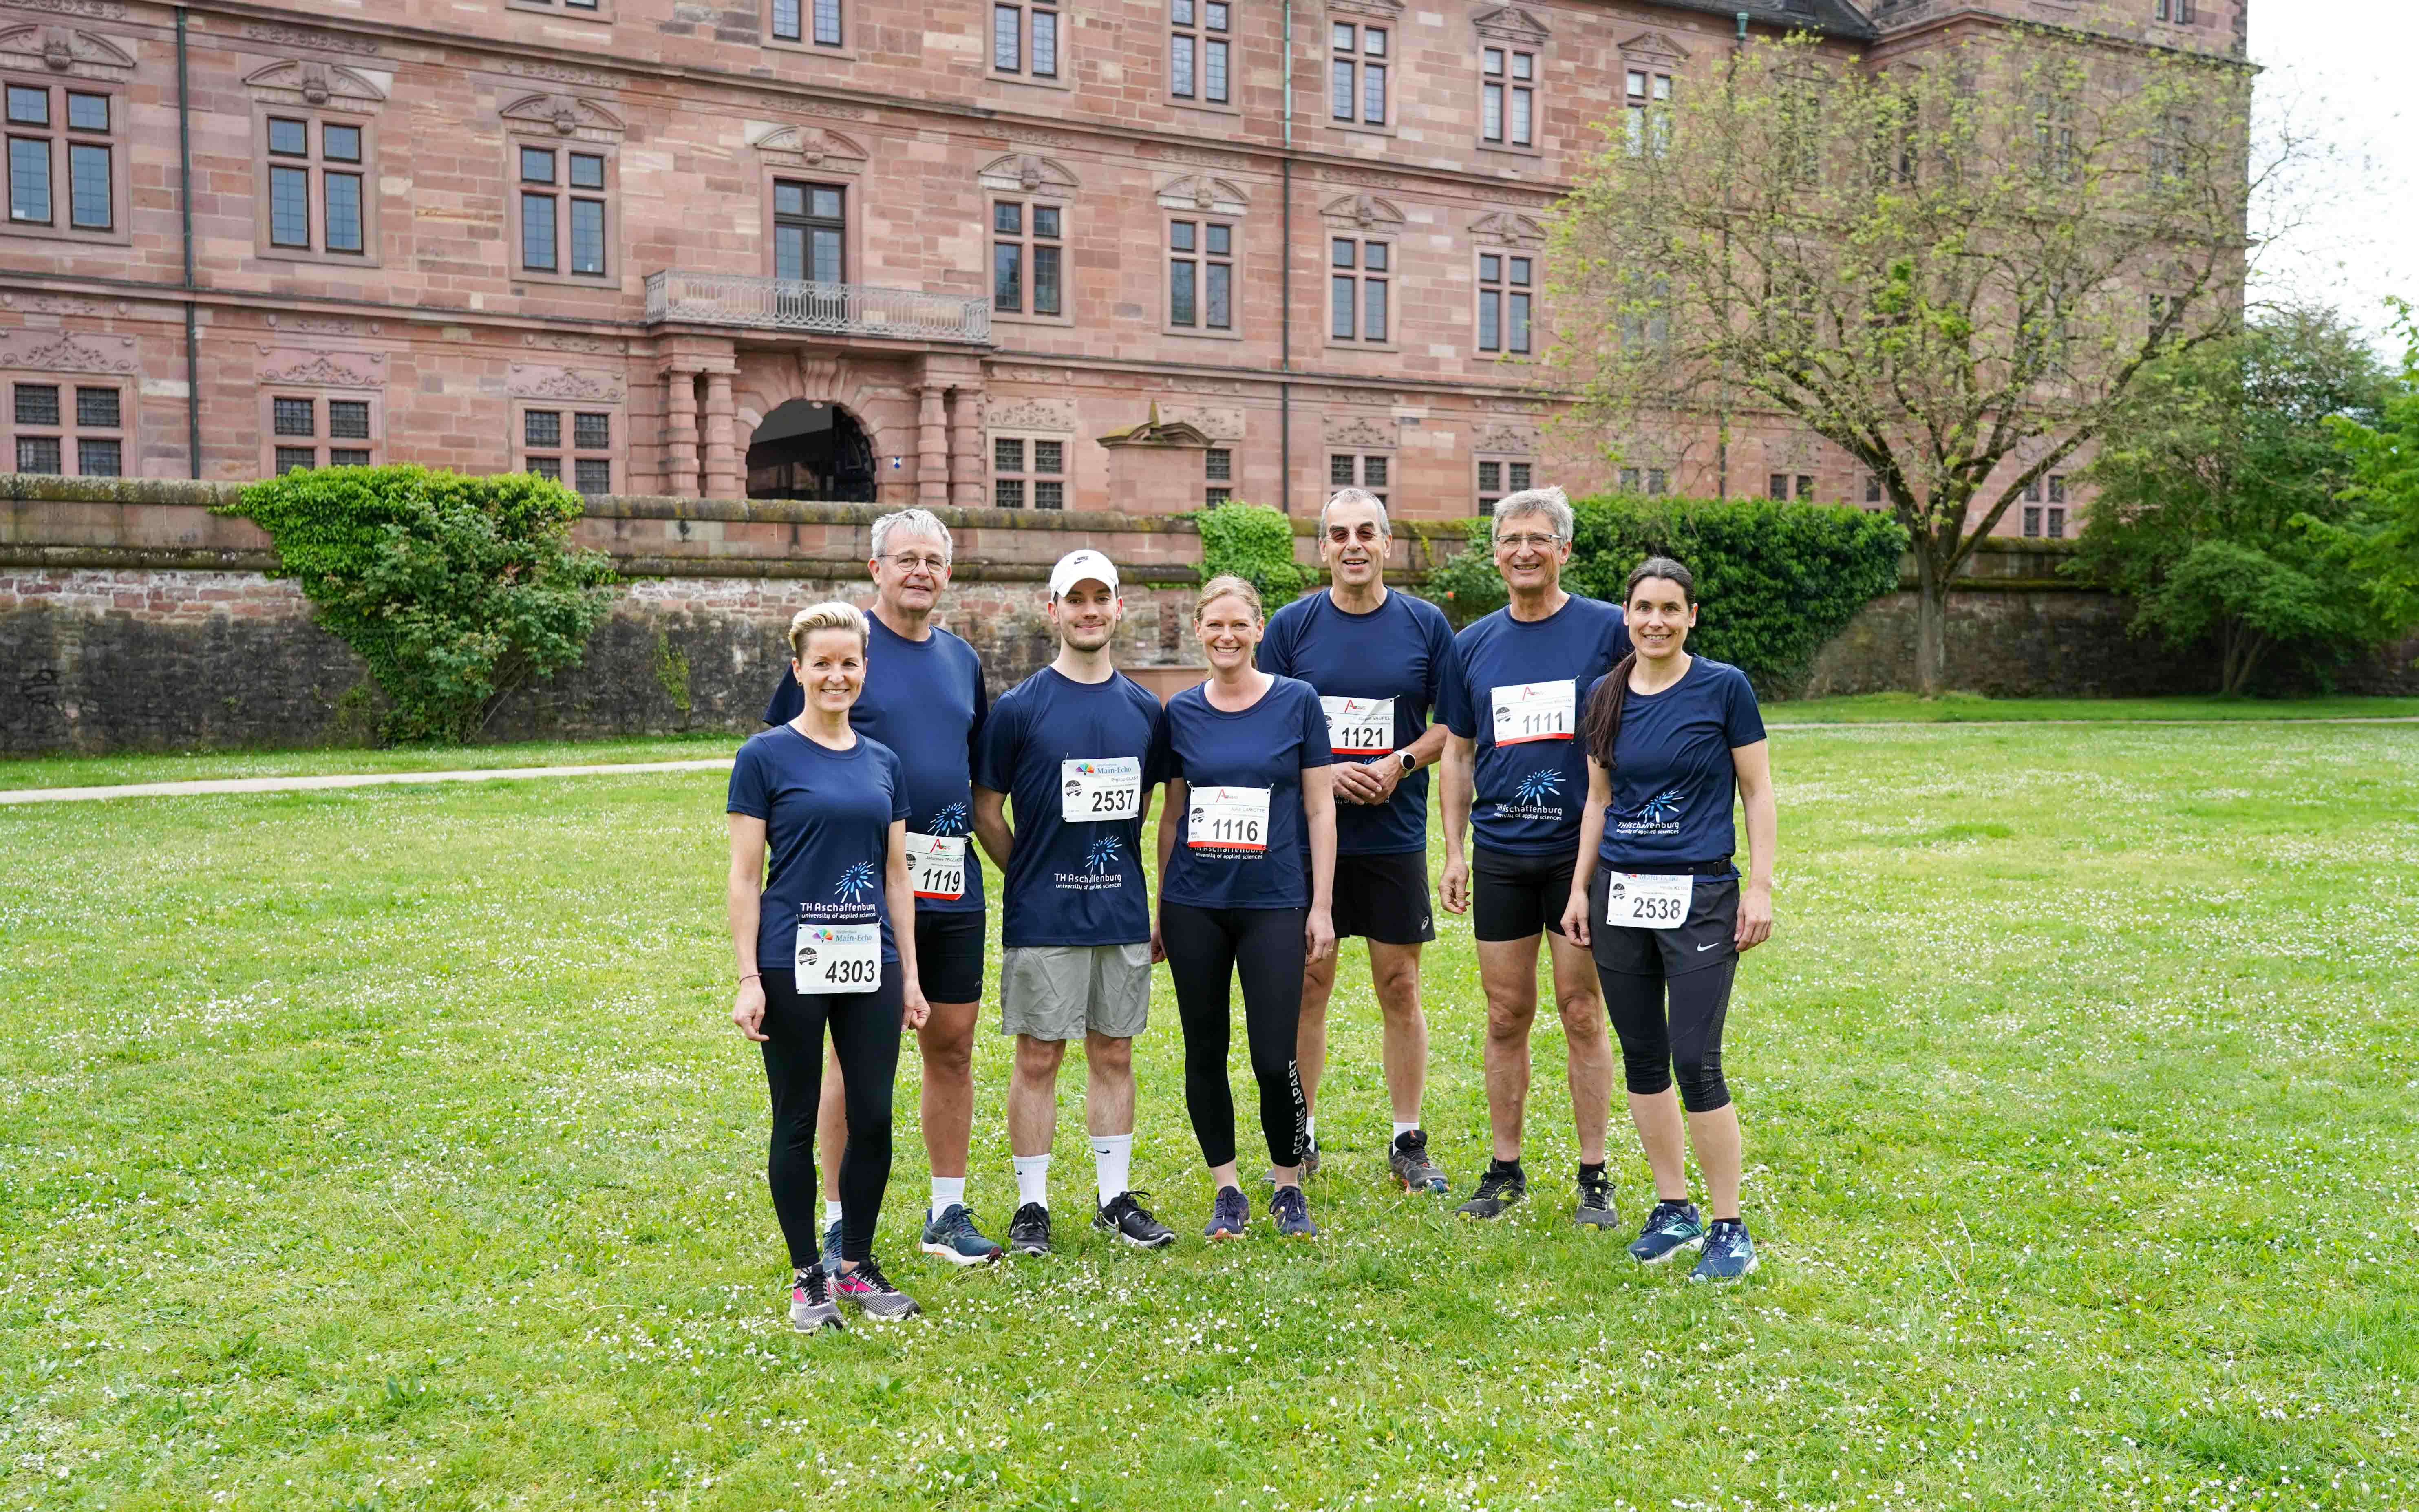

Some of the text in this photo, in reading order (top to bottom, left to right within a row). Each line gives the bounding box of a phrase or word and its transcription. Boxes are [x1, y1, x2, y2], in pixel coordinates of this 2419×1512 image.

[1523, 711, 1562, 734] 1111
[1342, 727, 1382, 747] 1121
[1092, 789, 1134, 812] 2537
[1213, 819, 1258, 841] 1116
[923, 868, 960, 892] 1119
[1054, 873, 1066, 881] TH
[800, 903, 876, 912] TH Aschaffenburg
[1633, 897, 1680, 919] 2538
[836, 934, 872, 942] Main-Echo
[825, 960, 874, 983] 4303
[1289, 1060, 1305, 1154] OCEANS APART
